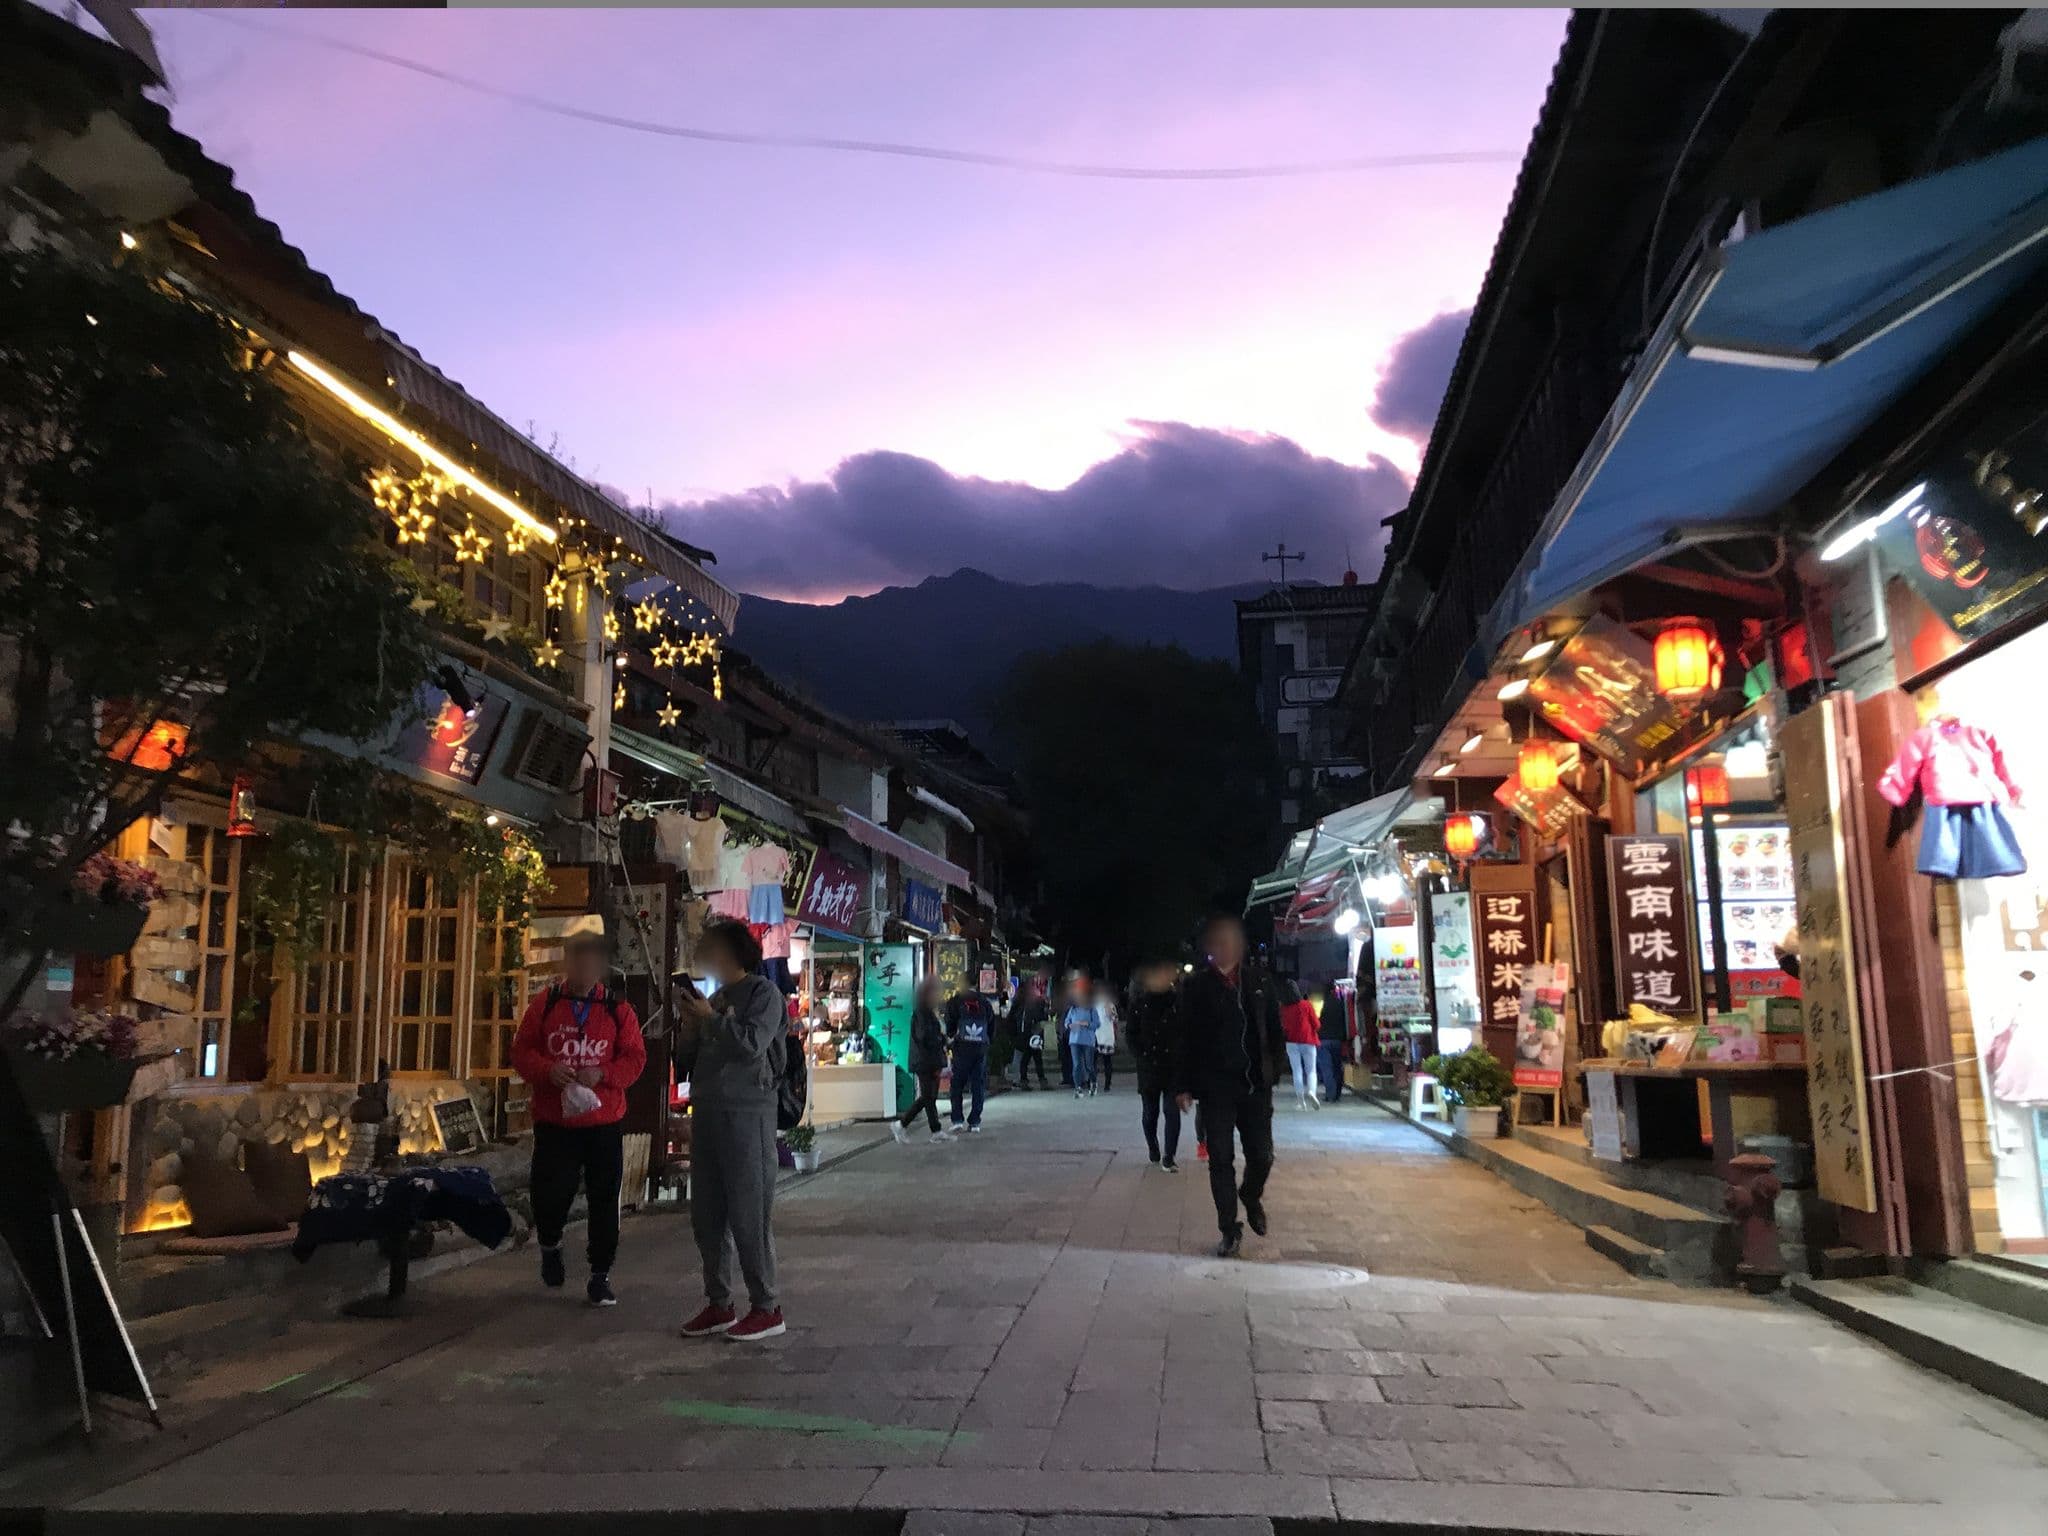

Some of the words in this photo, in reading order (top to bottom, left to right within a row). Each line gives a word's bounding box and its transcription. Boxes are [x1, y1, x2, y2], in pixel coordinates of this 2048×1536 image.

[1621, 842, 1682, 1005] 雲南味道
[547, 1032, 609, 1057] Coke
